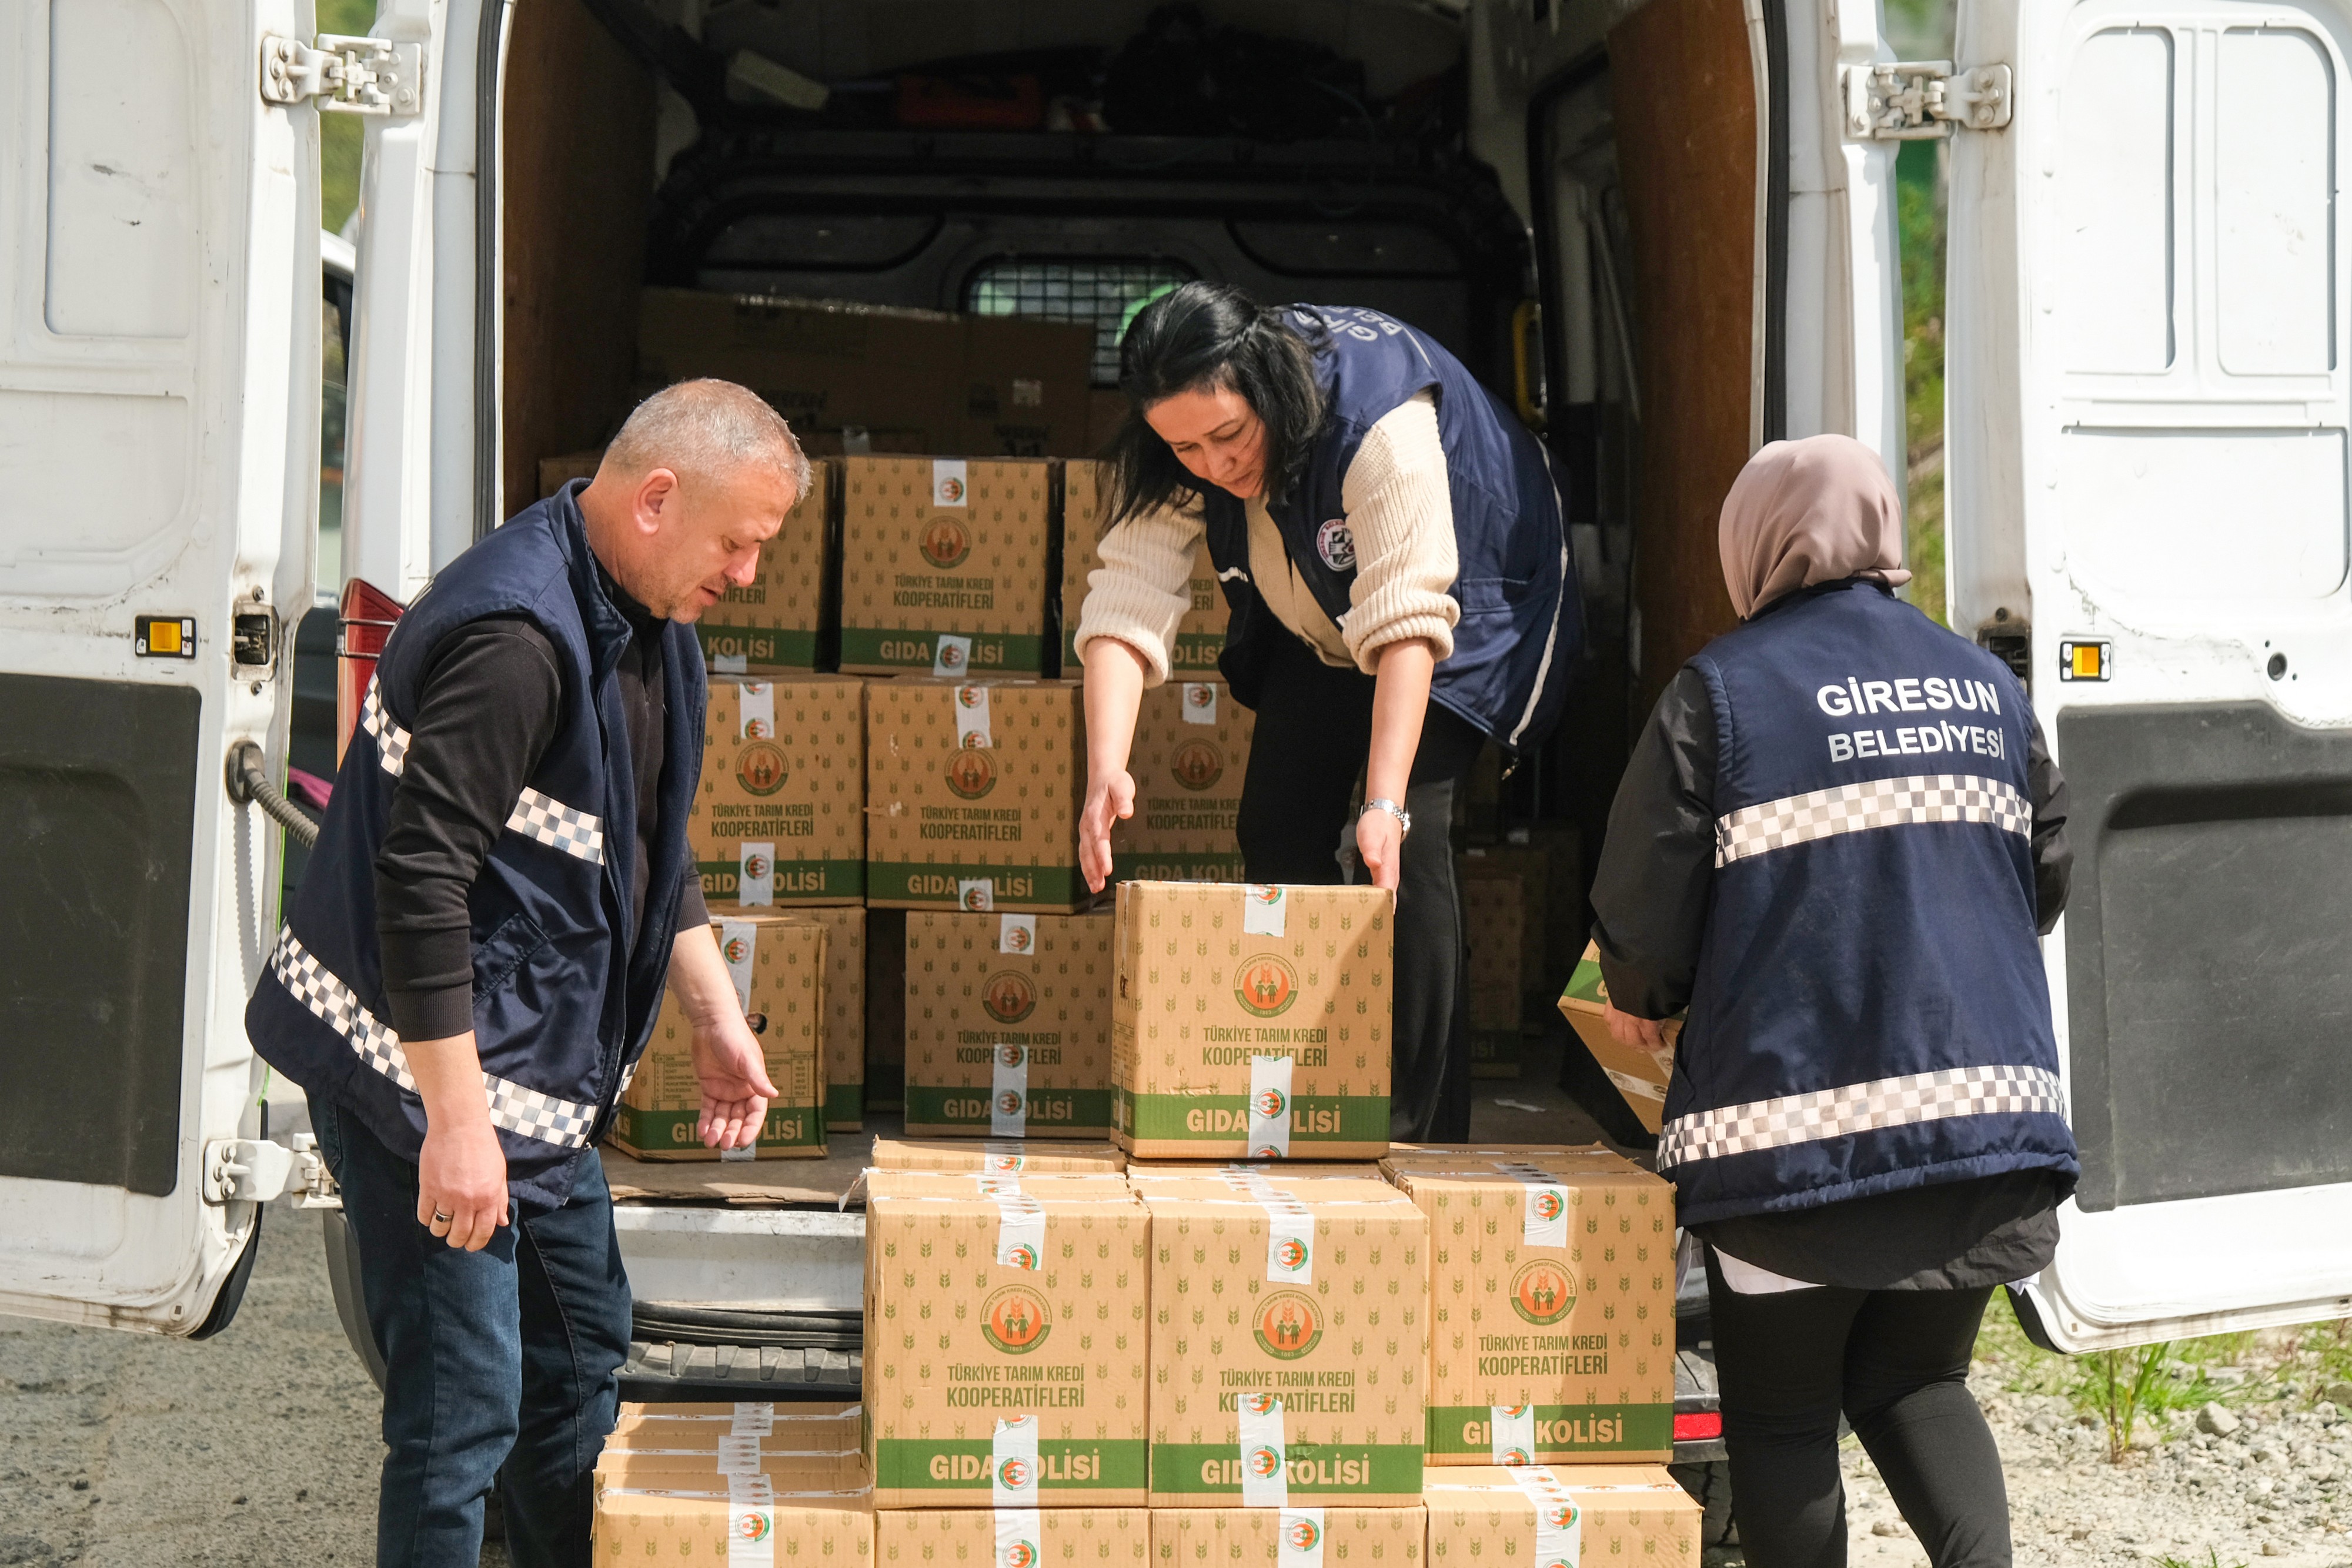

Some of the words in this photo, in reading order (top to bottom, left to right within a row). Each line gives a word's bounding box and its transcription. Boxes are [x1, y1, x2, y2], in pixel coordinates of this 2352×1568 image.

[895, 574, 933, 589] TÜRKİYE
[936, 576, 964, 589] TARIM
[966, 577, 994, 590] KREDİ
[1190, 578, 1214, 591] REDİ
[893, 590, 994, 610] KOOPERATİFLERİ
[880, 640, 930, 661] GIDA
[1817, 677, 2001, 717] GİRESUN
[1828, 720, 2005, 763] BELEDİYESİ
[711, 803, 751, 817] TÜRKİYE
[754, 804, 783, 817] TARIM
[786, 802, 813, 817] KREDİ
[1148, 797, 1186, 810] TÜRKİYE
[1188, 798, 1217, 810] TARIM
[921, 805, 960, 820] TÜRKİYE
[962, 808, 991, 821] TARIM
[994, 807, 1021, 822] KREDİ
[1147, 811, 1236, 830] KOOPERATİFLE
[711, 818, 814, 837] KOOPERATİFLERİ
[920, 822, 1021, 841] KOOPERATİFLERİ
[701, 873, 740, 892] GID
[907, 874, 958, 894] GIDA
[957, 1029, 998, 1044] TÜRKİYE
[1001, 1032, 1030, 1044] TARIM
[1033, 1031, 1061, 1045] KREDİ
[1203, 1025, 1251, 1042] TÜRKİYE
[1255, 1028, 1290, 1043] TARIM
[1294, 1027, 1327, 1043] KREDİ
[1187, 1109, 1249, 1132] GIDA
[1292, 1104, 1341, 1133] LİSİ
[1479, 1334, 1529, 1351] TÜRKİYE
[1532, 1335, 1569, 1351] TARIM
[1572, 1333, 1608, 1350] KREDİ
[947, 1363, 1000, 1381] TÜRKİYE
[1004, 1366, 1043, 1381] TARIM
[1047, 1363, 1084, 1381] KREDİ
[1479, 1352, 1608, 1376] KOOPERATİFLERİ
[1220, 1369, 1272, 1386] TÜRKİYE
[1275, 1371, 1315, 1386] TARIM
[1318, 1369, 1355, 1387] KREDİ
[947, 1383, 1085, 1407] KOOPERATİFLERİ
[1463, 1421, 1491, 1445] GI
[1536, 1412, 1623, 1444] KOLİSİ
